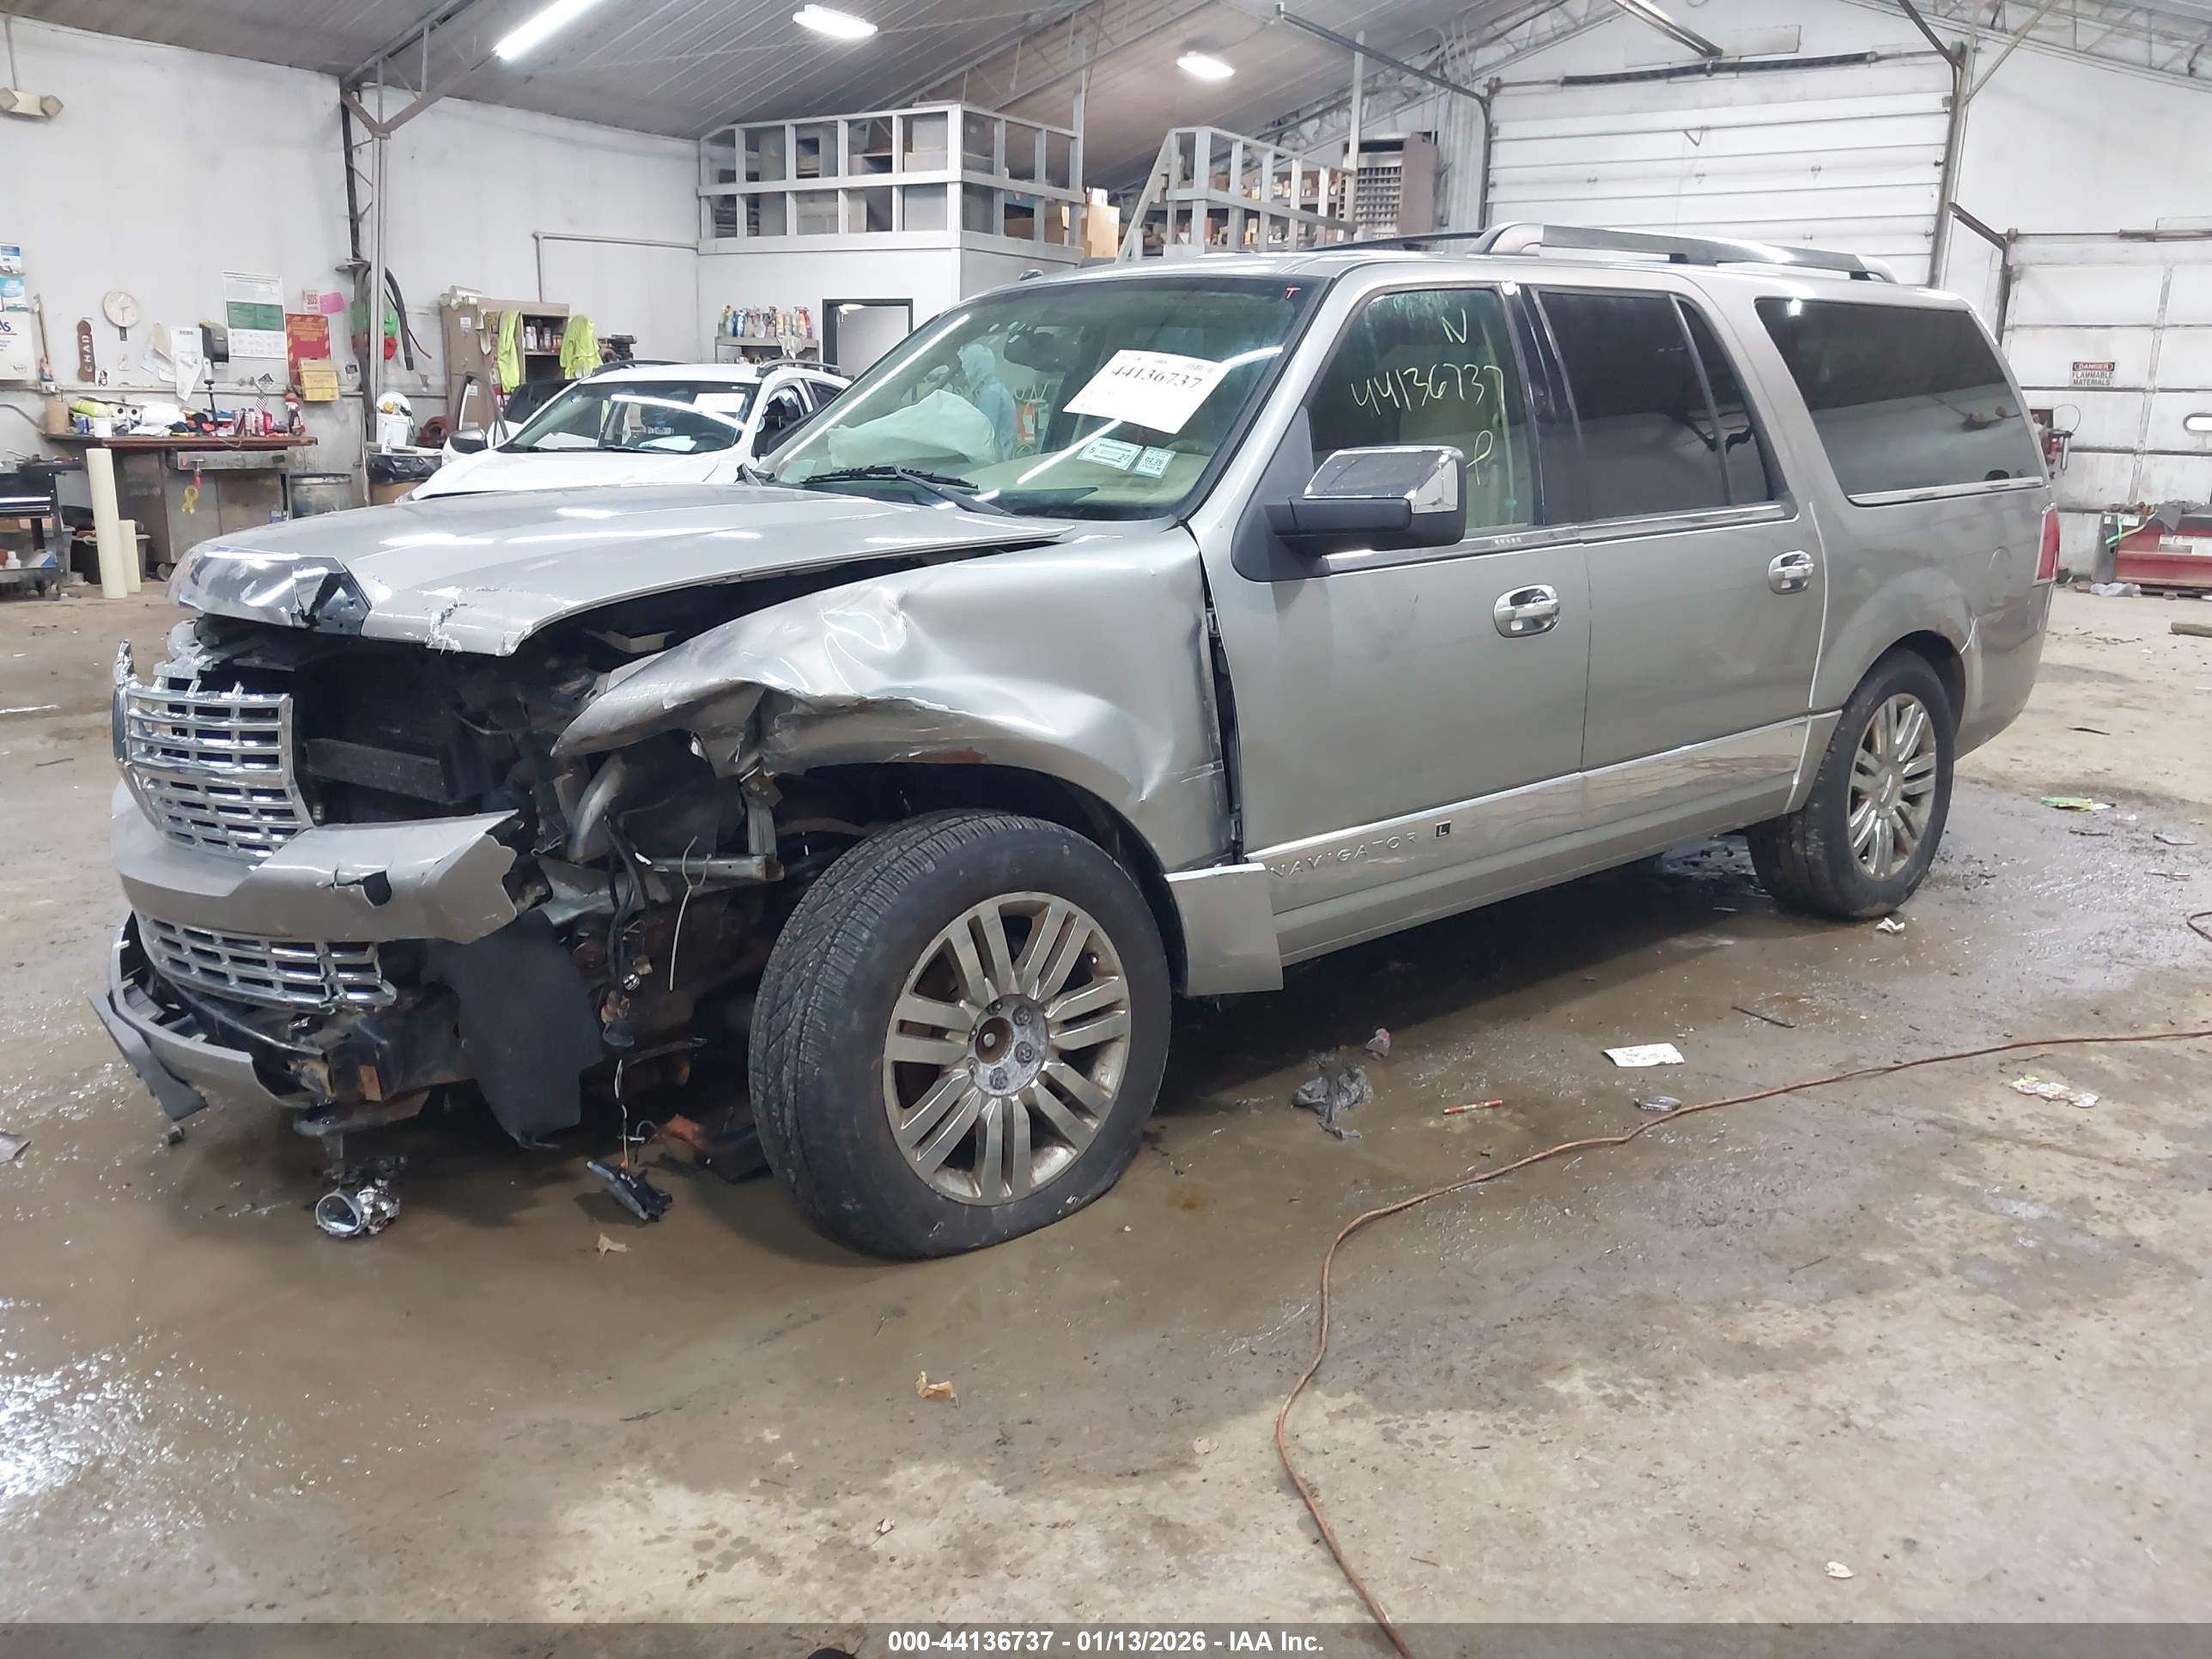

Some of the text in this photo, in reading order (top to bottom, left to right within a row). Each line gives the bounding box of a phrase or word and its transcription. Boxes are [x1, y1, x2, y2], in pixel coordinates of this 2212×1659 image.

[1441, 308, 1467, 343] N
[82, 335, 93, 373] CHAD
[1111, 365, 1203, 389] 44136737
[1351, 362, 1505, 416] 44136737
[1270, 831, 1417, 878] NAVIGATOR
